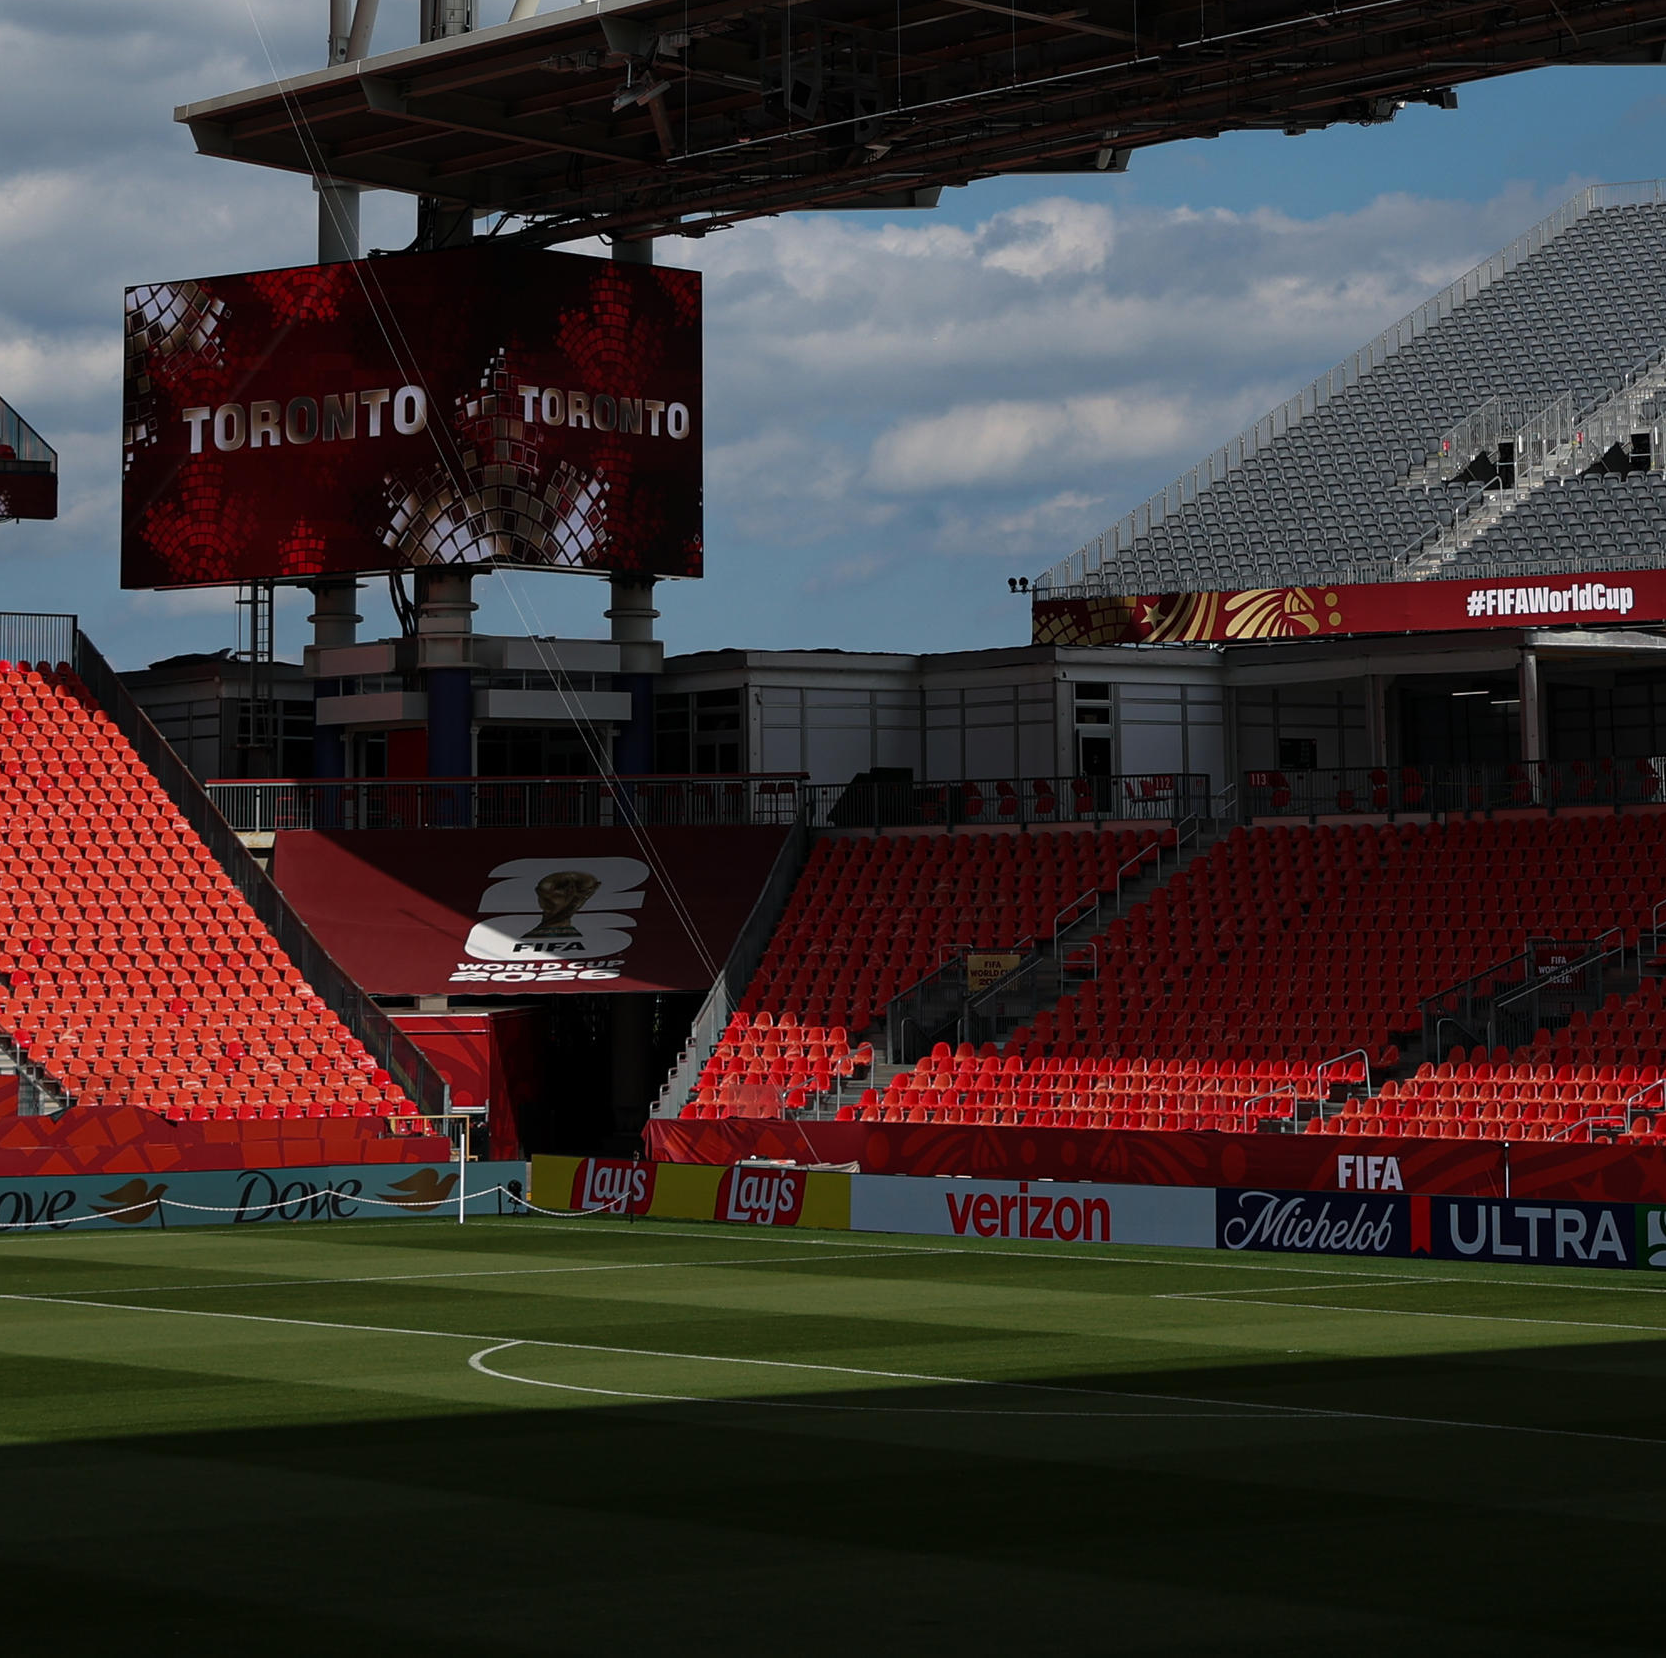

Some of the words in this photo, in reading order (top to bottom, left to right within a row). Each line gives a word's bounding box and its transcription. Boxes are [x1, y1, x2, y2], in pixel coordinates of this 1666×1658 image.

[182, 384, 427, 455] TORONTO
[517, 384, 691, 440] TORONTO
[1466, 583, 1635, 617] #FIFAWorldCup
[1155, 776, 1171, 789] 112
[1251, 773, 1266, 785] 113
[457, 962, 563, 971] WORLD
[567, 959, 625, 969] CUP
[513, 942, 585, 952] FIFA
[1551, 956, 1567, 964] FIFA
[448, 969, 621, 982] 2026
[582, 1159, 647, 1213] Lay's
[1337, 1154, 1404, 1191] FIFA
[233, 1169, 363, 1223] Dove
[728, 1167, 795, 1225] Lay's
[946, 1182, 1110, 1241] verizon
[1224, 1191, 1395, 1252] Michelob
[1449, 1203, 1628, 1261] ULTRA
